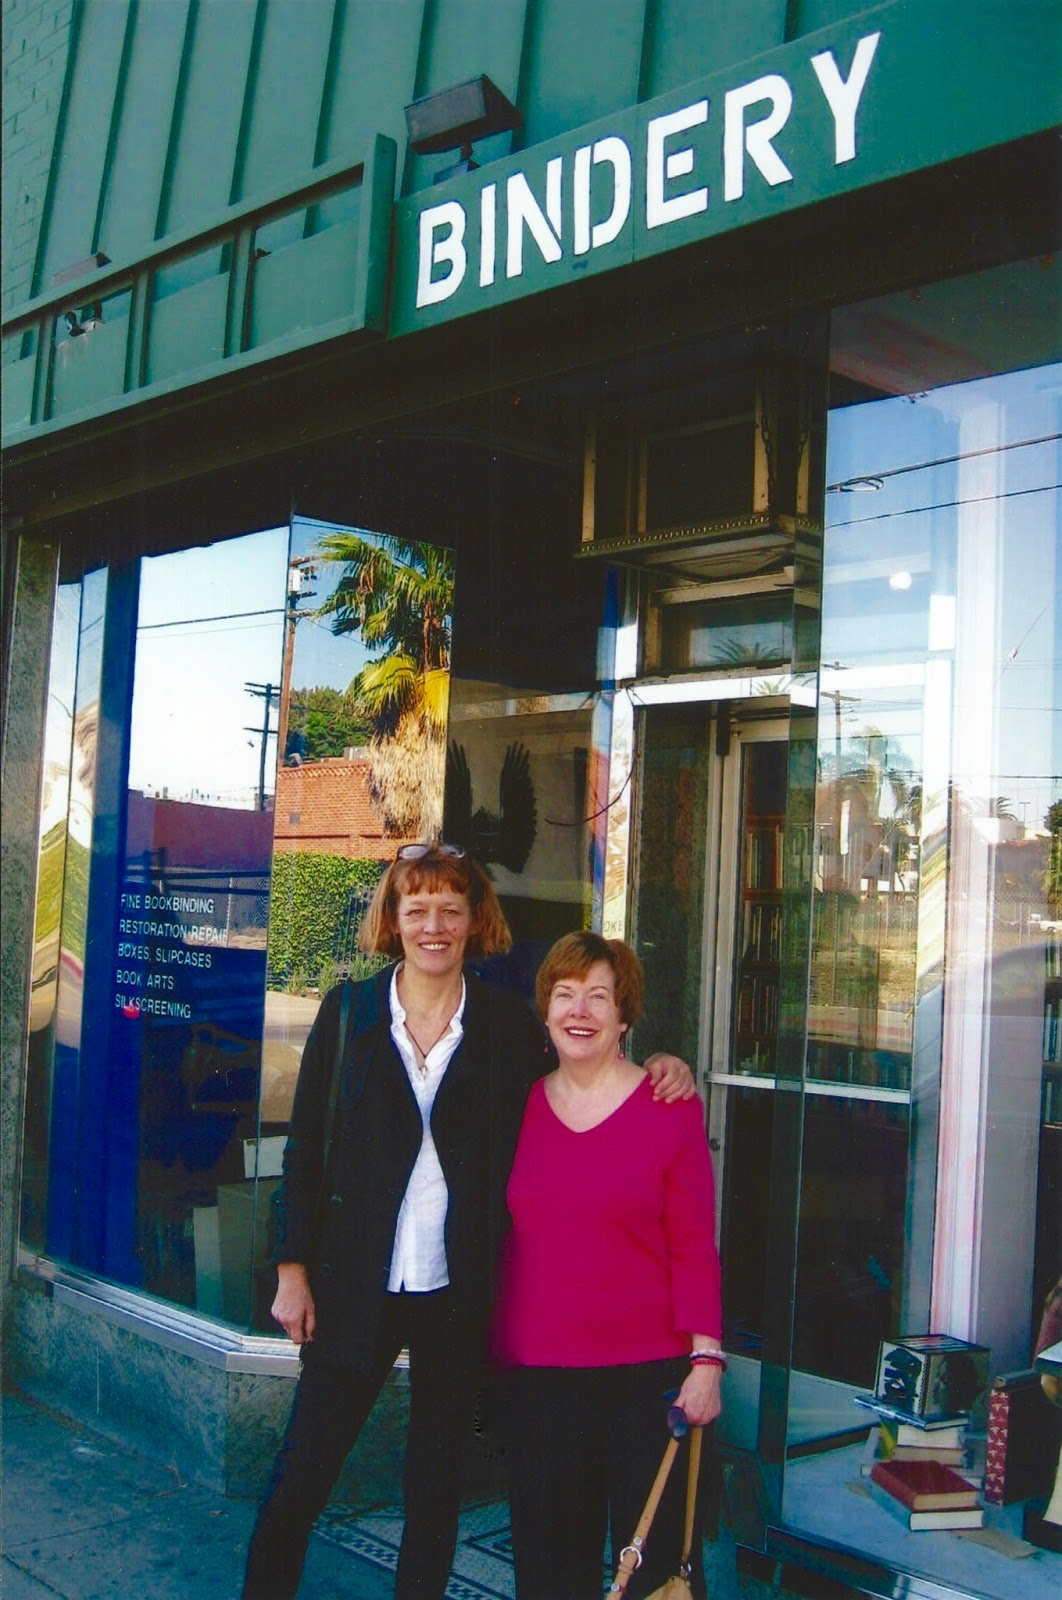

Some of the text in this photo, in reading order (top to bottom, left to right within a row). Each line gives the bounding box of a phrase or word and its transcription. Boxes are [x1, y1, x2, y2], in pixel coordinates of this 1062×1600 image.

[416, 31, 881, 309] BINDERY
[120, 894, 214, 914] FINE BOOKBINDING
[155, 947, 212, 968] SLIPCASES
[116, 969, 174, 990] BOOK ARTS
[115, 994, 191, 1019] SILKSCREENING
